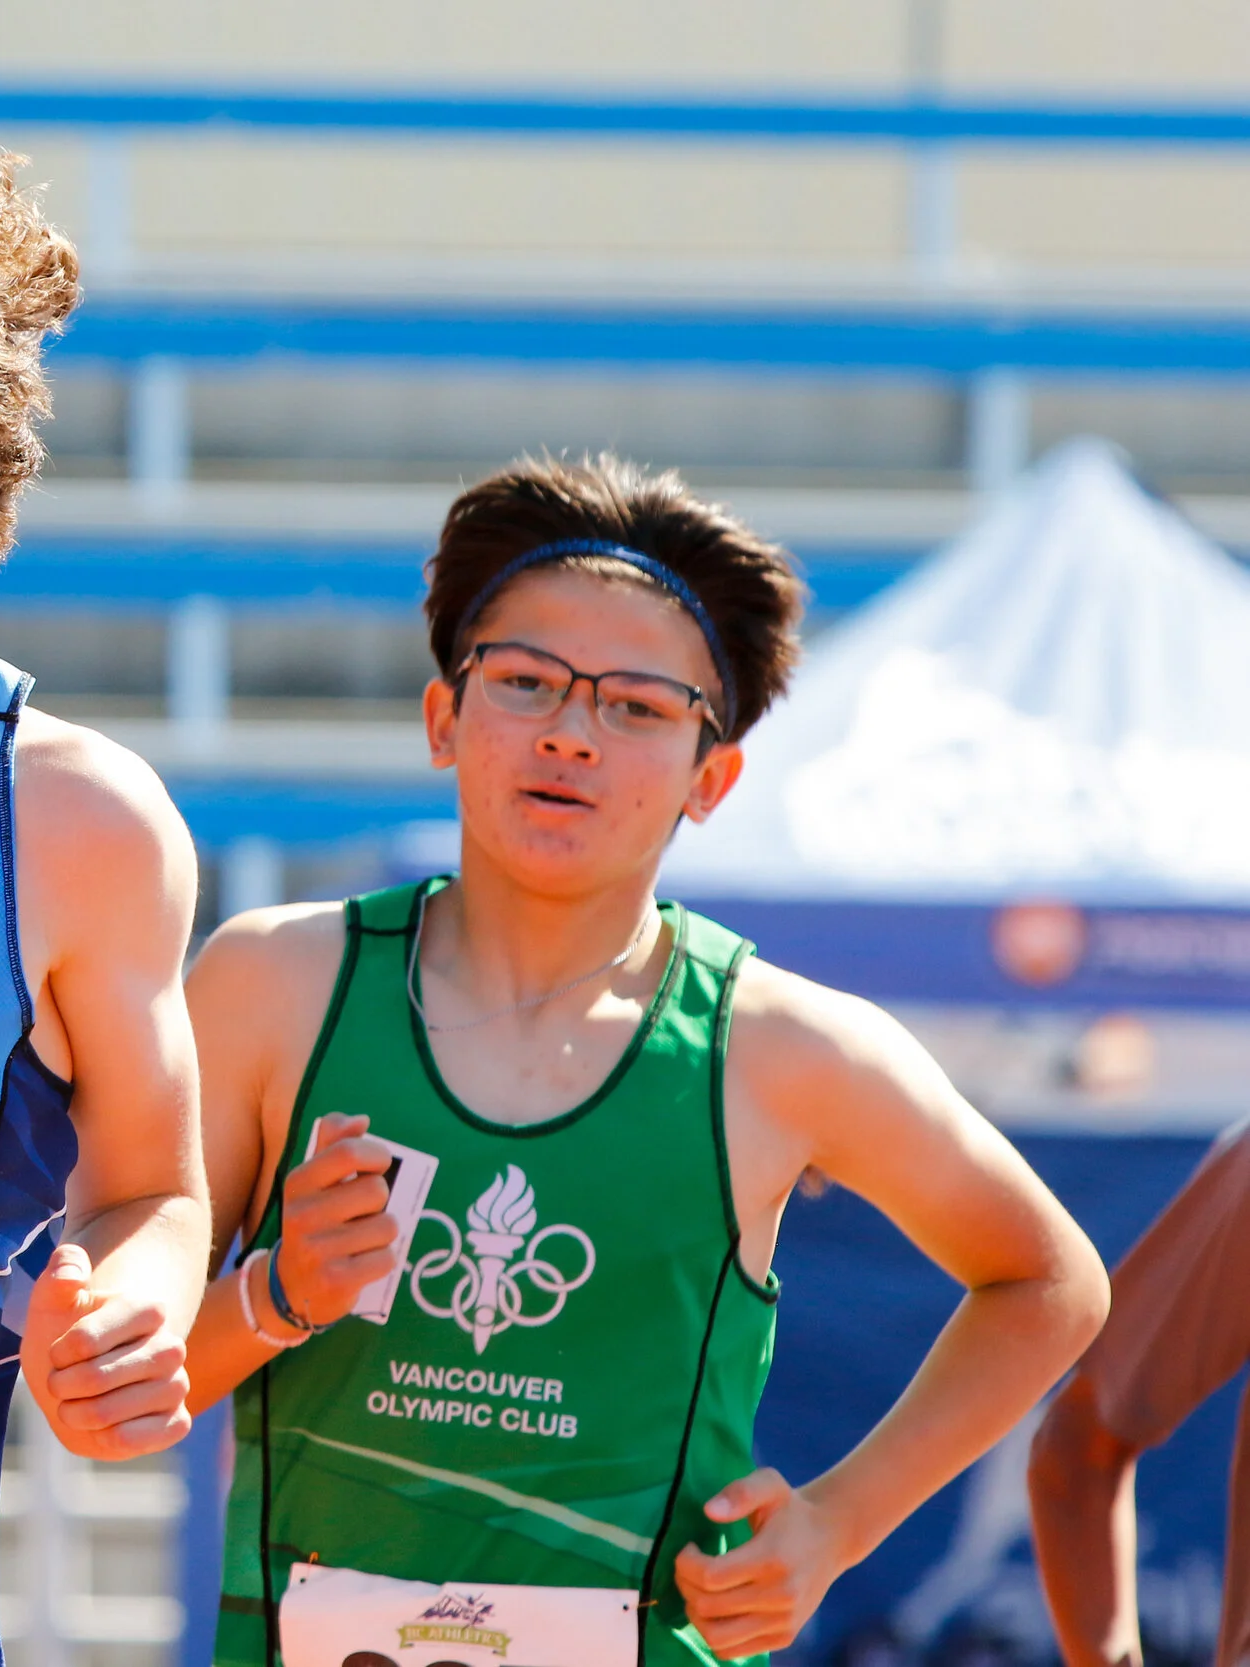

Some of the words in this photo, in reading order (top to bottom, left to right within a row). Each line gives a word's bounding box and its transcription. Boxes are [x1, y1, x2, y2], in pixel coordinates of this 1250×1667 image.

[388, 1360, 564, 1403] VANCOUVER
[367, 1391, 493, 1428] OLYMPIC
[500, 1408, 579, 1440] CLUB
[428, 1627, 505, 1649] ATHLETICS
